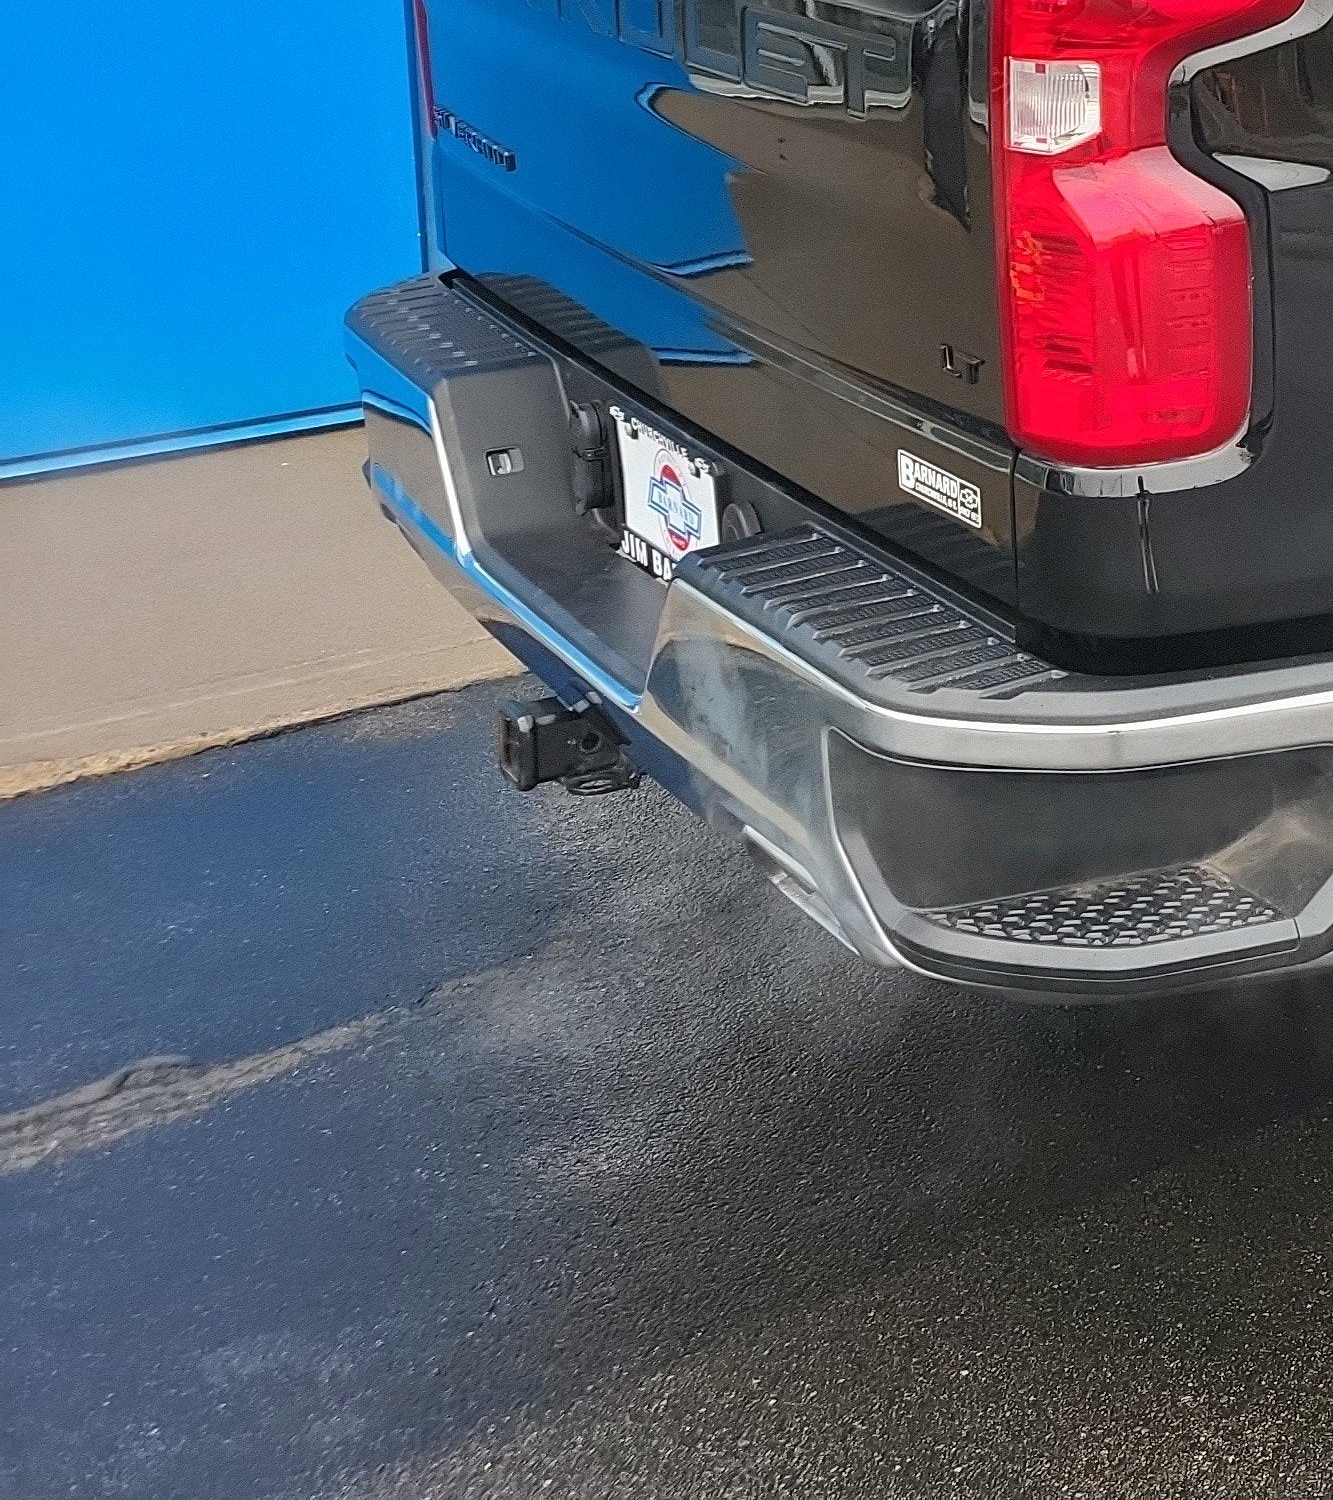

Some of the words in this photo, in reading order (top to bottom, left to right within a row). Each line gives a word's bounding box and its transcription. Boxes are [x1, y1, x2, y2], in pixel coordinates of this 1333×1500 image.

[939, 343, 986, 385] LT
[899, 453, 959, 500] BARNARD
[620, 530, 649, 568] JIM
[652, 548, 678, 581] BA
